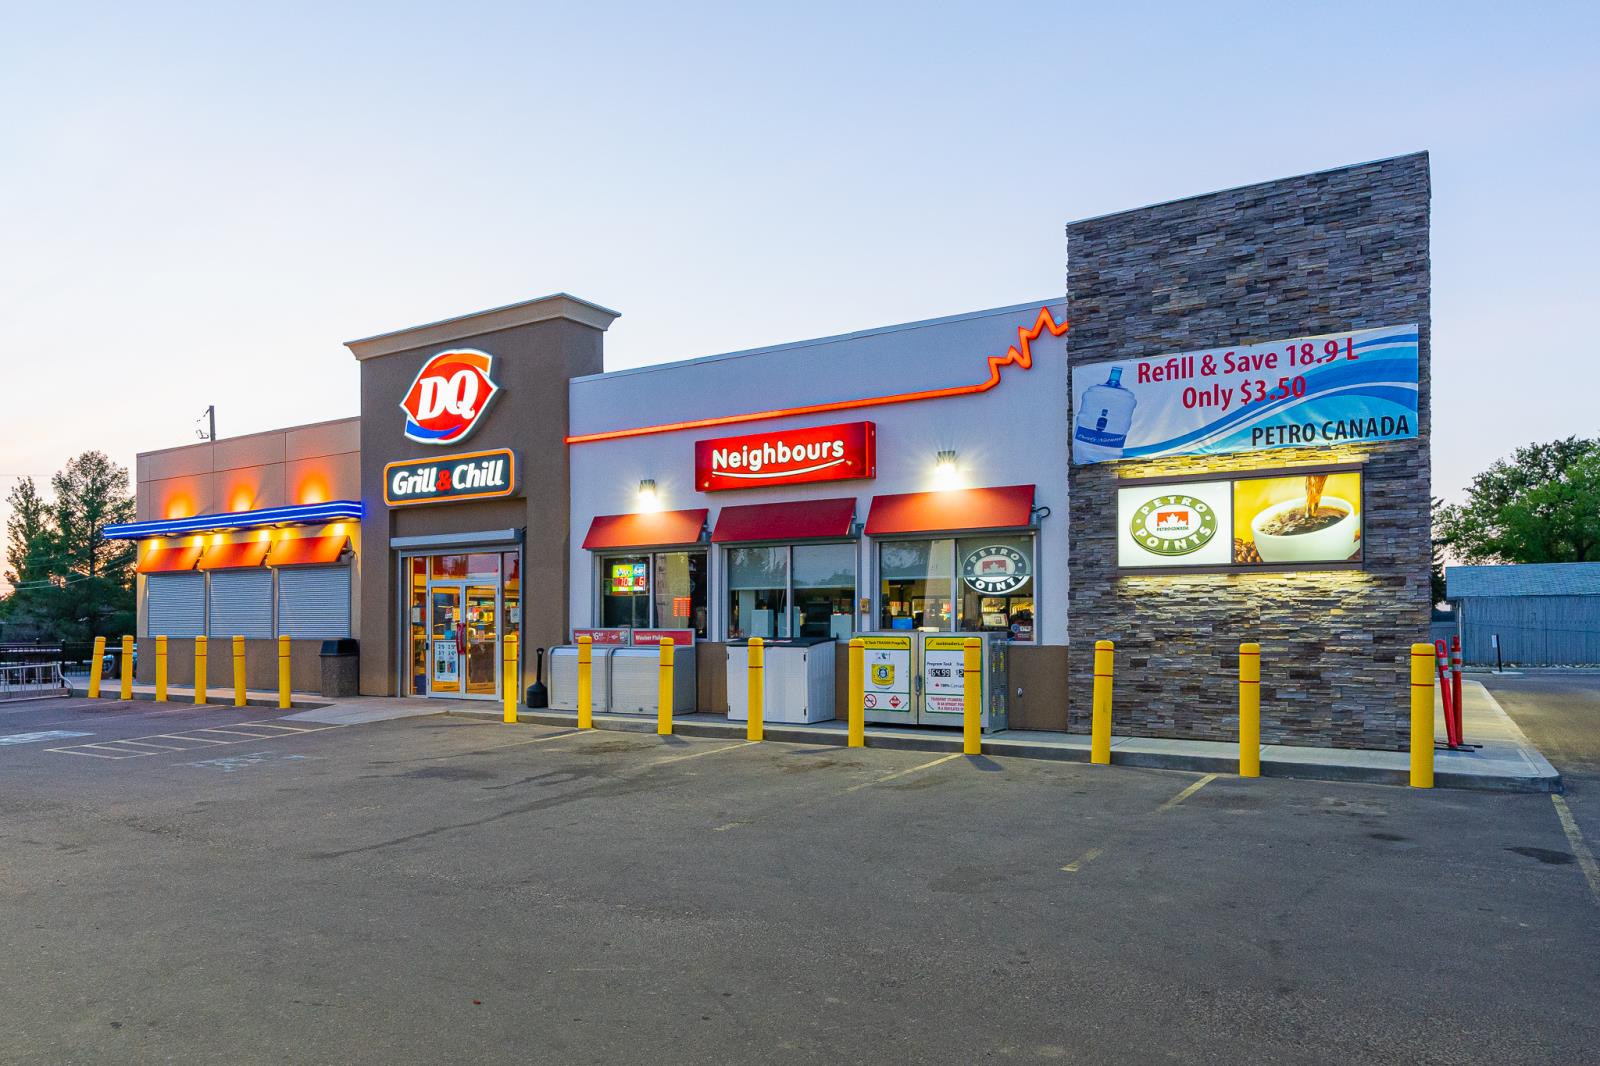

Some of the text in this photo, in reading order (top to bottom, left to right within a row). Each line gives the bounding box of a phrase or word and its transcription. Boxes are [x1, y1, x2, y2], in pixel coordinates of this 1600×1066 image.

[1137, 337, 1359, 384] Refill & Save 18.9 L
[416, 369, 479, 421] DQ
[1182, 375, 1307, 412] Only $3.50
[1251, 415, 1410, 446] PETRO CANADA
[712, 440, 845, 471] Neighbours
[392, 467, 437, 495] Grill
[452, 459, 504, 490] Chill
[1140, 496, 1208, 515] PETRO
[1135, 526, 1212, 551] POINTS
[969, 547, 1020, 563] PETRO
